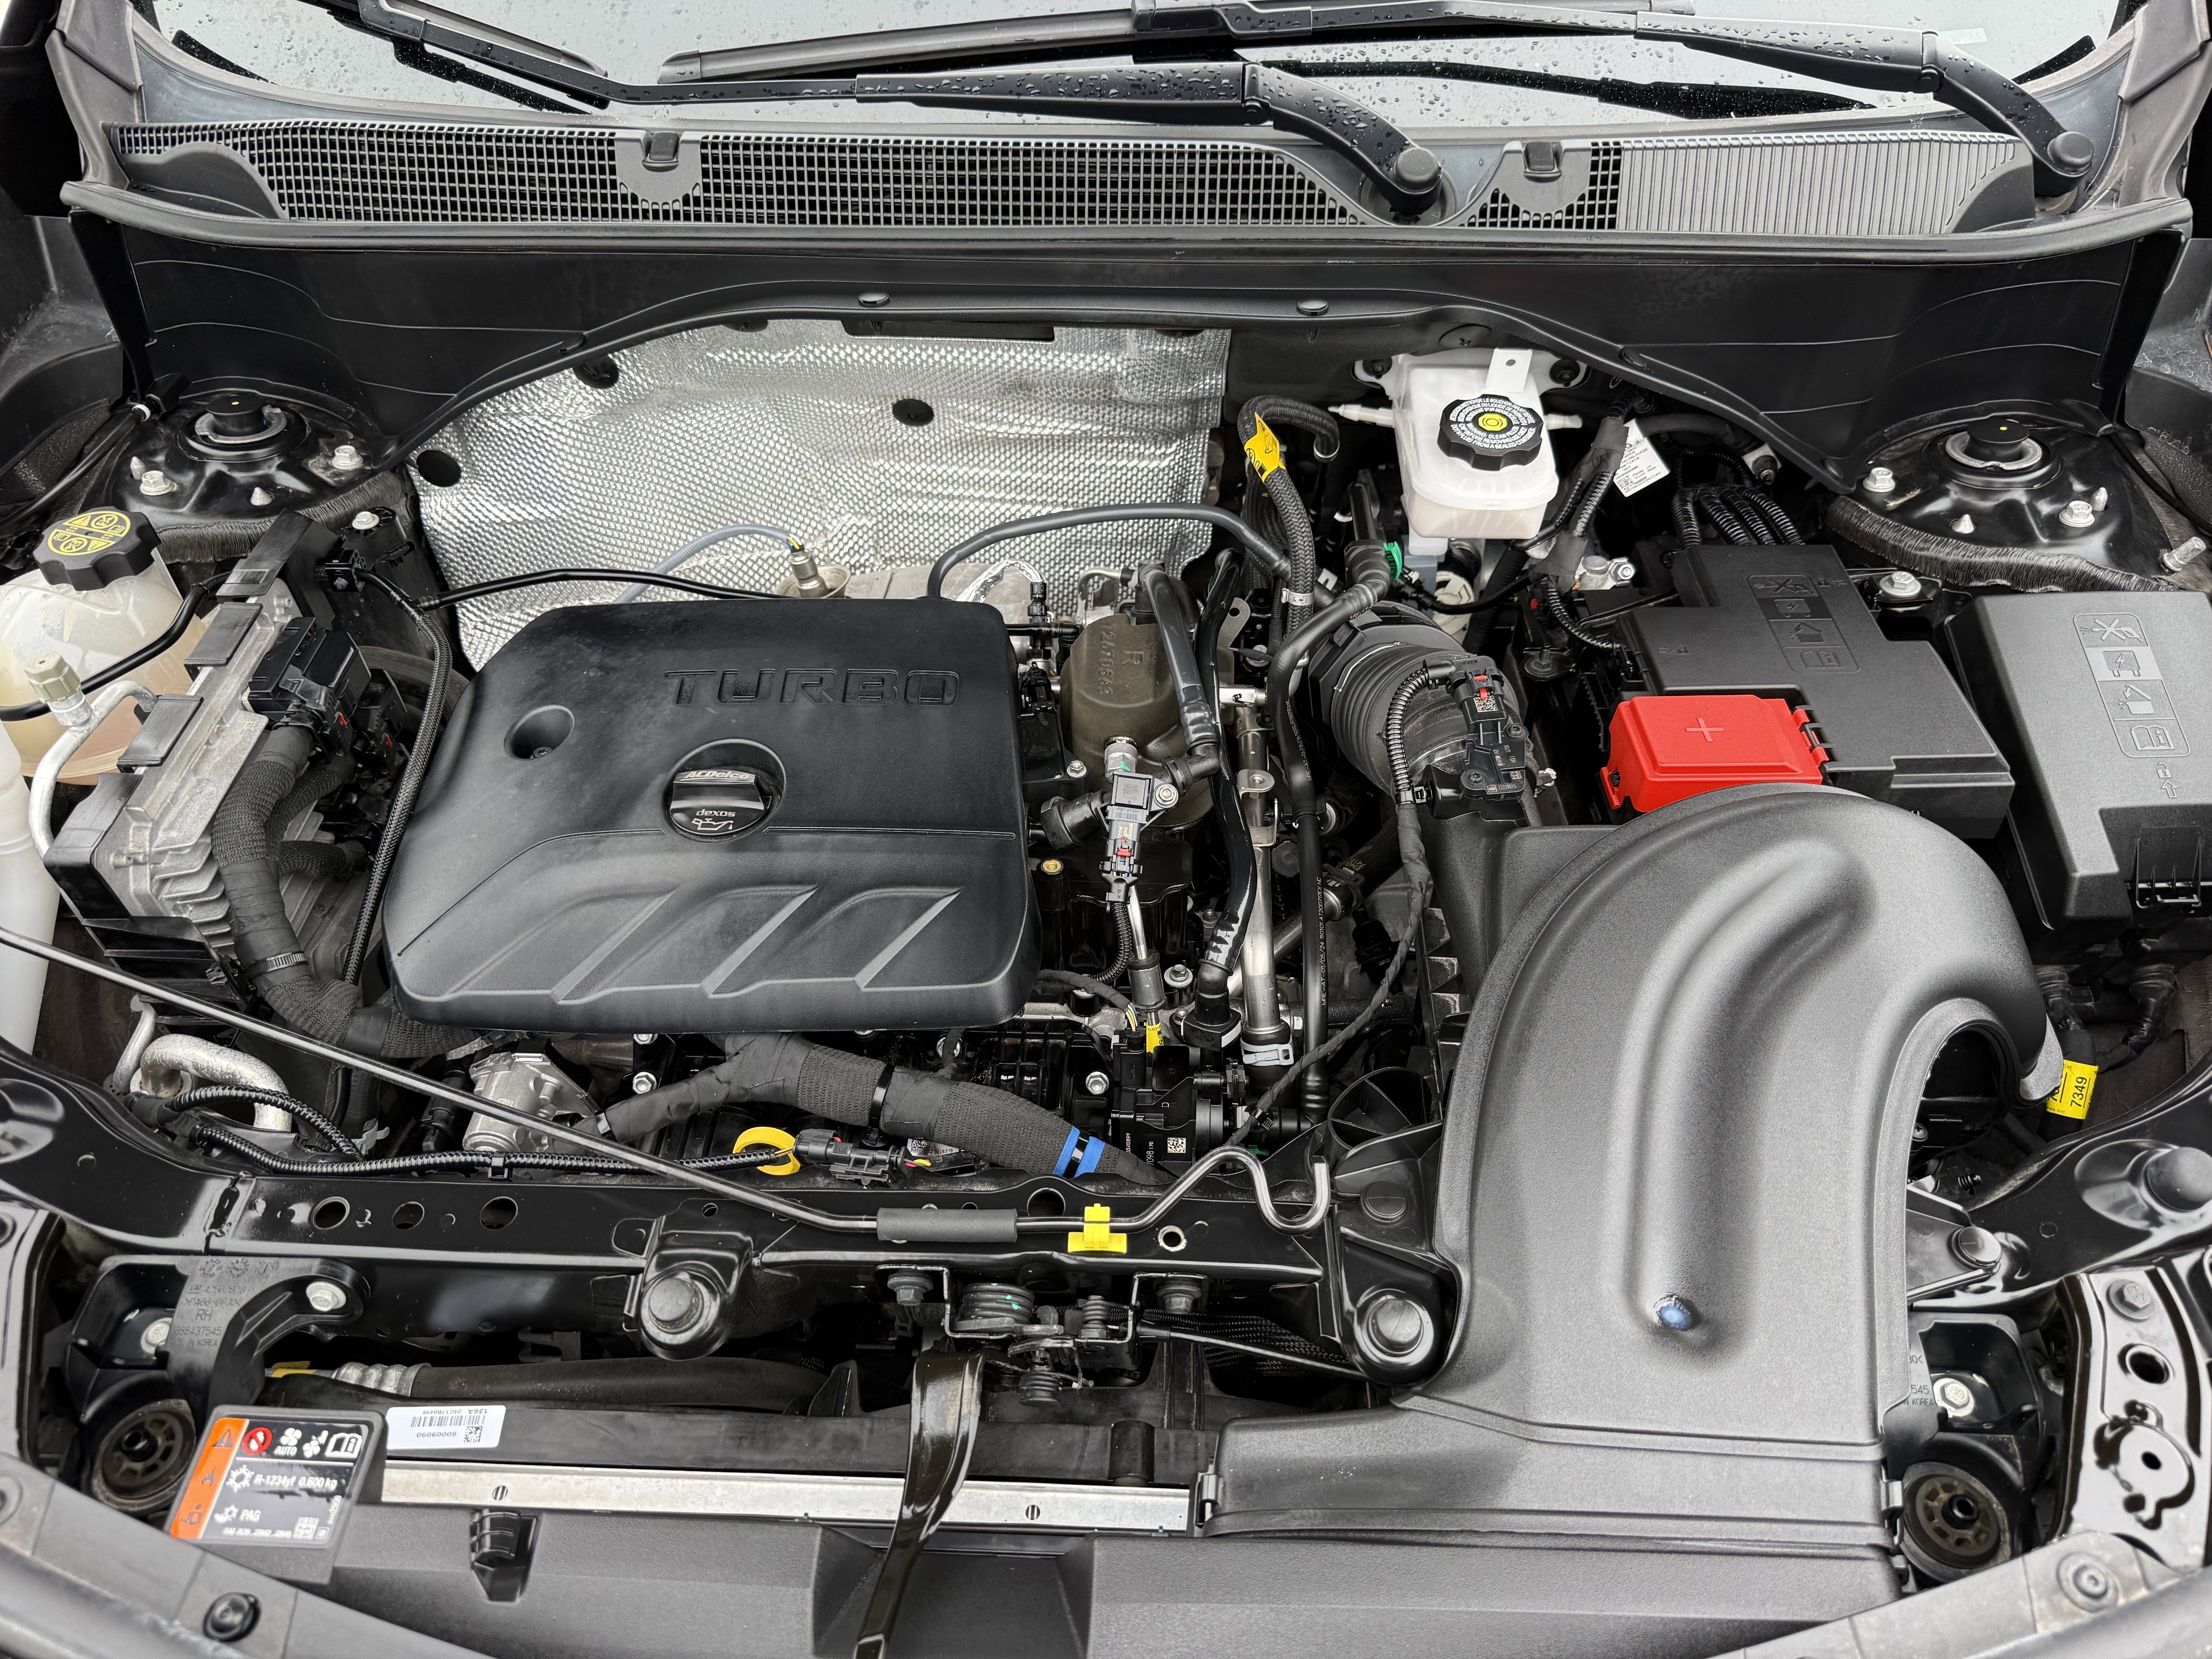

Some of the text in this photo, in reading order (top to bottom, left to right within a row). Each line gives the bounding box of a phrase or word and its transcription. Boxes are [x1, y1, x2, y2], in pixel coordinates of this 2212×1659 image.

[664, 668, 960, 706] TURBO
[684, 770, 750, 781] ACDelco
[696, 808, 736, 818] dexos
[2070, 1076, 2087, 1107] 7349
[195, 1308, 213, 1321] RH
[198, 1338, 218, 1346] KOREA
[1912, 1398, 1935, 1407] KOREA
[274, 1446, 297, 1457] AUTO
[254, 1474, 296, 1488] R-1234yf
[298, 1476, 325, 1488] 0.600
[240, 1509, 261, 1522] PAG
